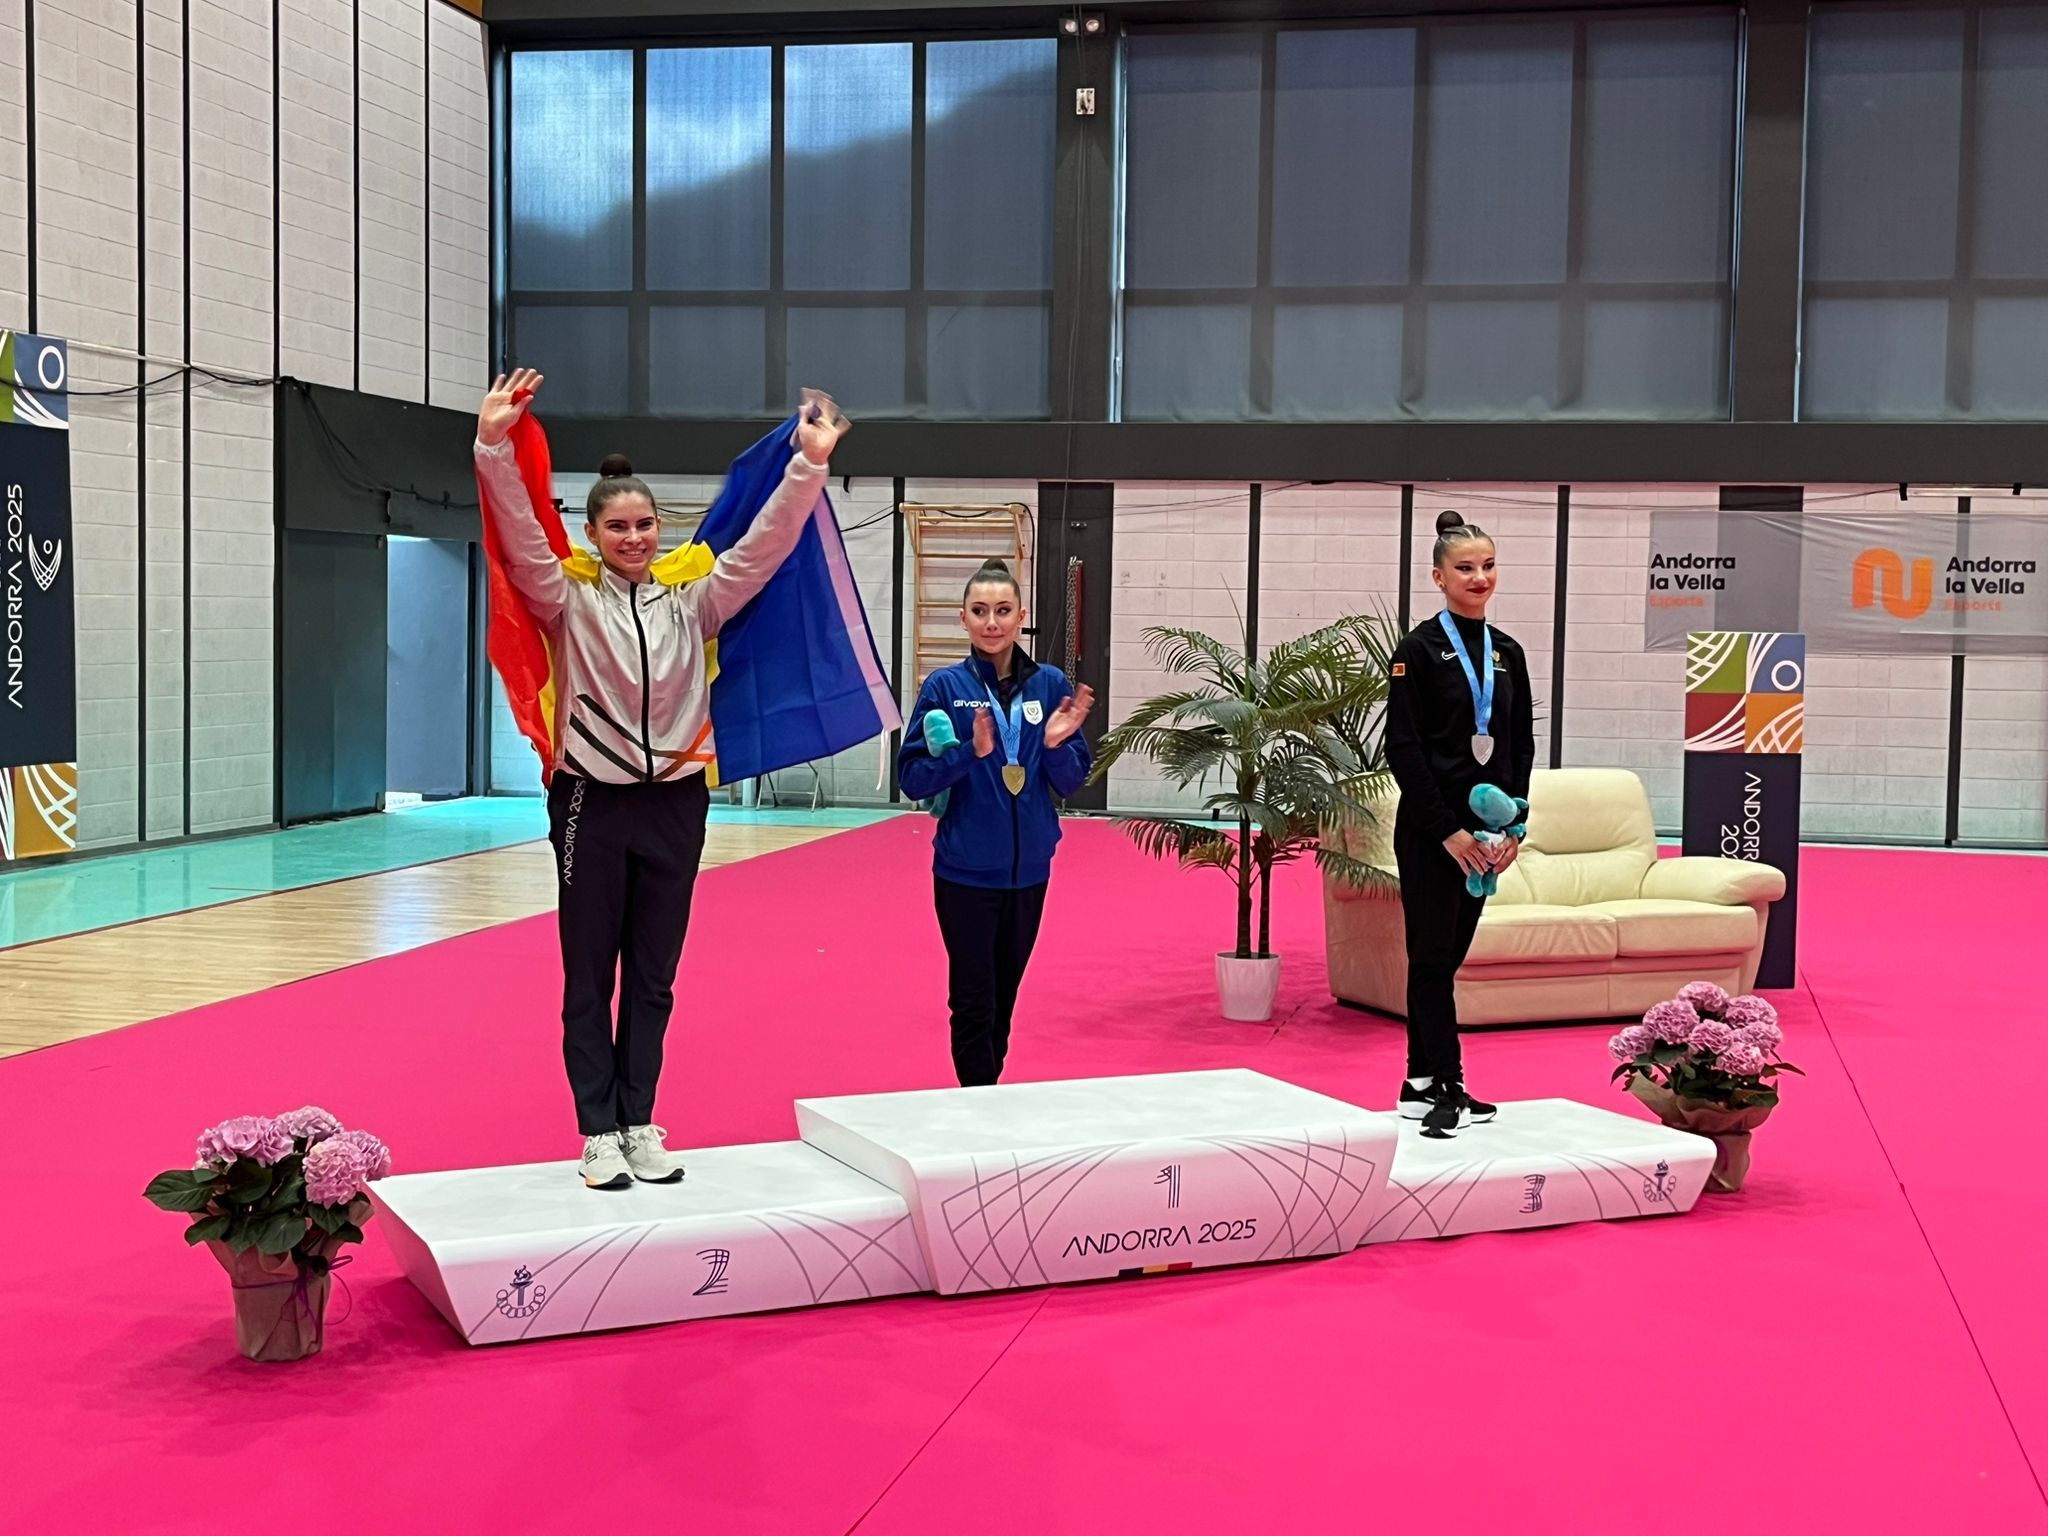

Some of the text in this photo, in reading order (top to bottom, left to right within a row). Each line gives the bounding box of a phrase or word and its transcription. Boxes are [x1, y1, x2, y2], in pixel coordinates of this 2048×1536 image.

[1650, 553, 1736, 569] Andorra
[1650, 574, 1725, 590] la Vella
[1946, 556, 2036, 573] Andorra
[7, 484, 23, 709] ANDORRA 2025
[1945, 577, 2025, 594] la Vella
[563, 780, 587, 885] ANDORRA 2025
[1743, 771, 1761, 861] ANDORR
[1153, 1164, 1181, 1209] 1
[1062, 1218, 1257, 1258] ANDORRA 2025
[692, 1248, 730, 1296] 2
